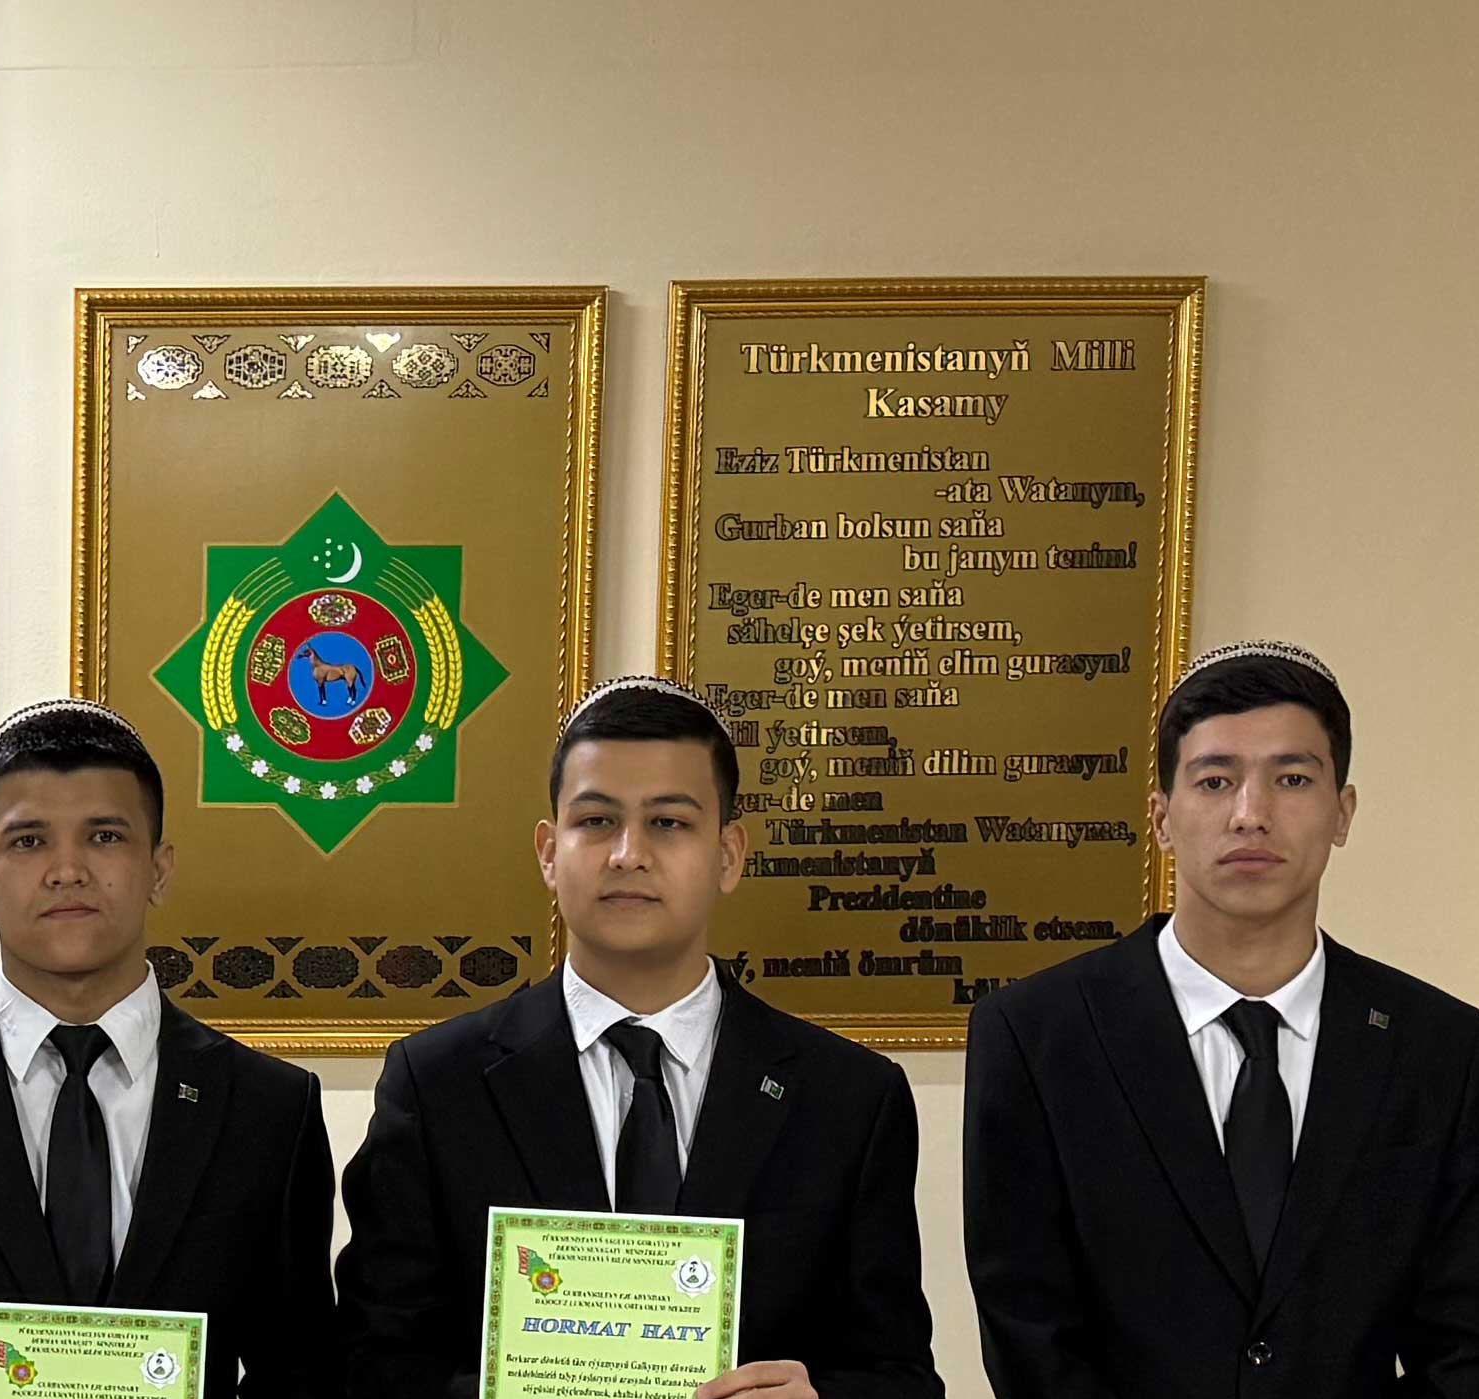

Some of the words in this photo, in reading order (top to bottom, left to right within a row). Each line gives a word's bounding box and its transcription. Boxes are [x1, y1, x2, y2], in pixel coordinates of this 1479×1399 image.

[741, 340, 1030, 379] Türkmenistanyň
[1051, 338, 1135, 373] Milli
[865, 387, 1008, 424] Kasamy
[715, 447, 780, 474] Eziz
[785, 446, 990, 473] Türkmenistan
[935, 477, 991, 502] -ata
[998, 475, 1146, 509] Watanym,
[714, 513, 828, 541] Gurban
[836, 512, 932, 539] bolsun
[938, 509, 1005, 538] saňa
[902, 543, 940, 571] bu
[945, 542, 1038, 577] janym
[1045, 541, 1138, 569] tenim!
[708, 582, 822, 616] Eger-de
[830, 588, 890, 609] men
[898, 579, 964, 608] saňa
[727, 616, 830, 649] sähelçe
[838, 616, 885, 649] şek
[892, 614, 1023, 648] ýetirsem,
[774, 650, 833, 684] goý,
[841, 648, 930, 677] meniň
[938, 648, 999, 676] elim
[1006, 646, 1131, 681] gurasyn!
[705, 683, 818, 717] Eger-de
[826, 688, 887, 709] men
[895, 680, 960, 708] saňa
[765, 719, 898, 754] ýetirsem,
[760, 750, 819, 785] goý,
[826, 748, 916, 776] meniň
[922, 749, 997, 776] dilim
[1003, 746, 1129, 783] gurasyn!
[821, 791, 884, 812] men
[765, 817, 968, 845] Türkmenistan
[974, 816, 1137, 848] Watanyma,
[741, 848, 937, 882] rkmenistanyň
[807, 884, 987, 911] Prezidentine
[521, 1316, 632, 1338] HORMAT
[640, 1318, 712, 1343] HATY
